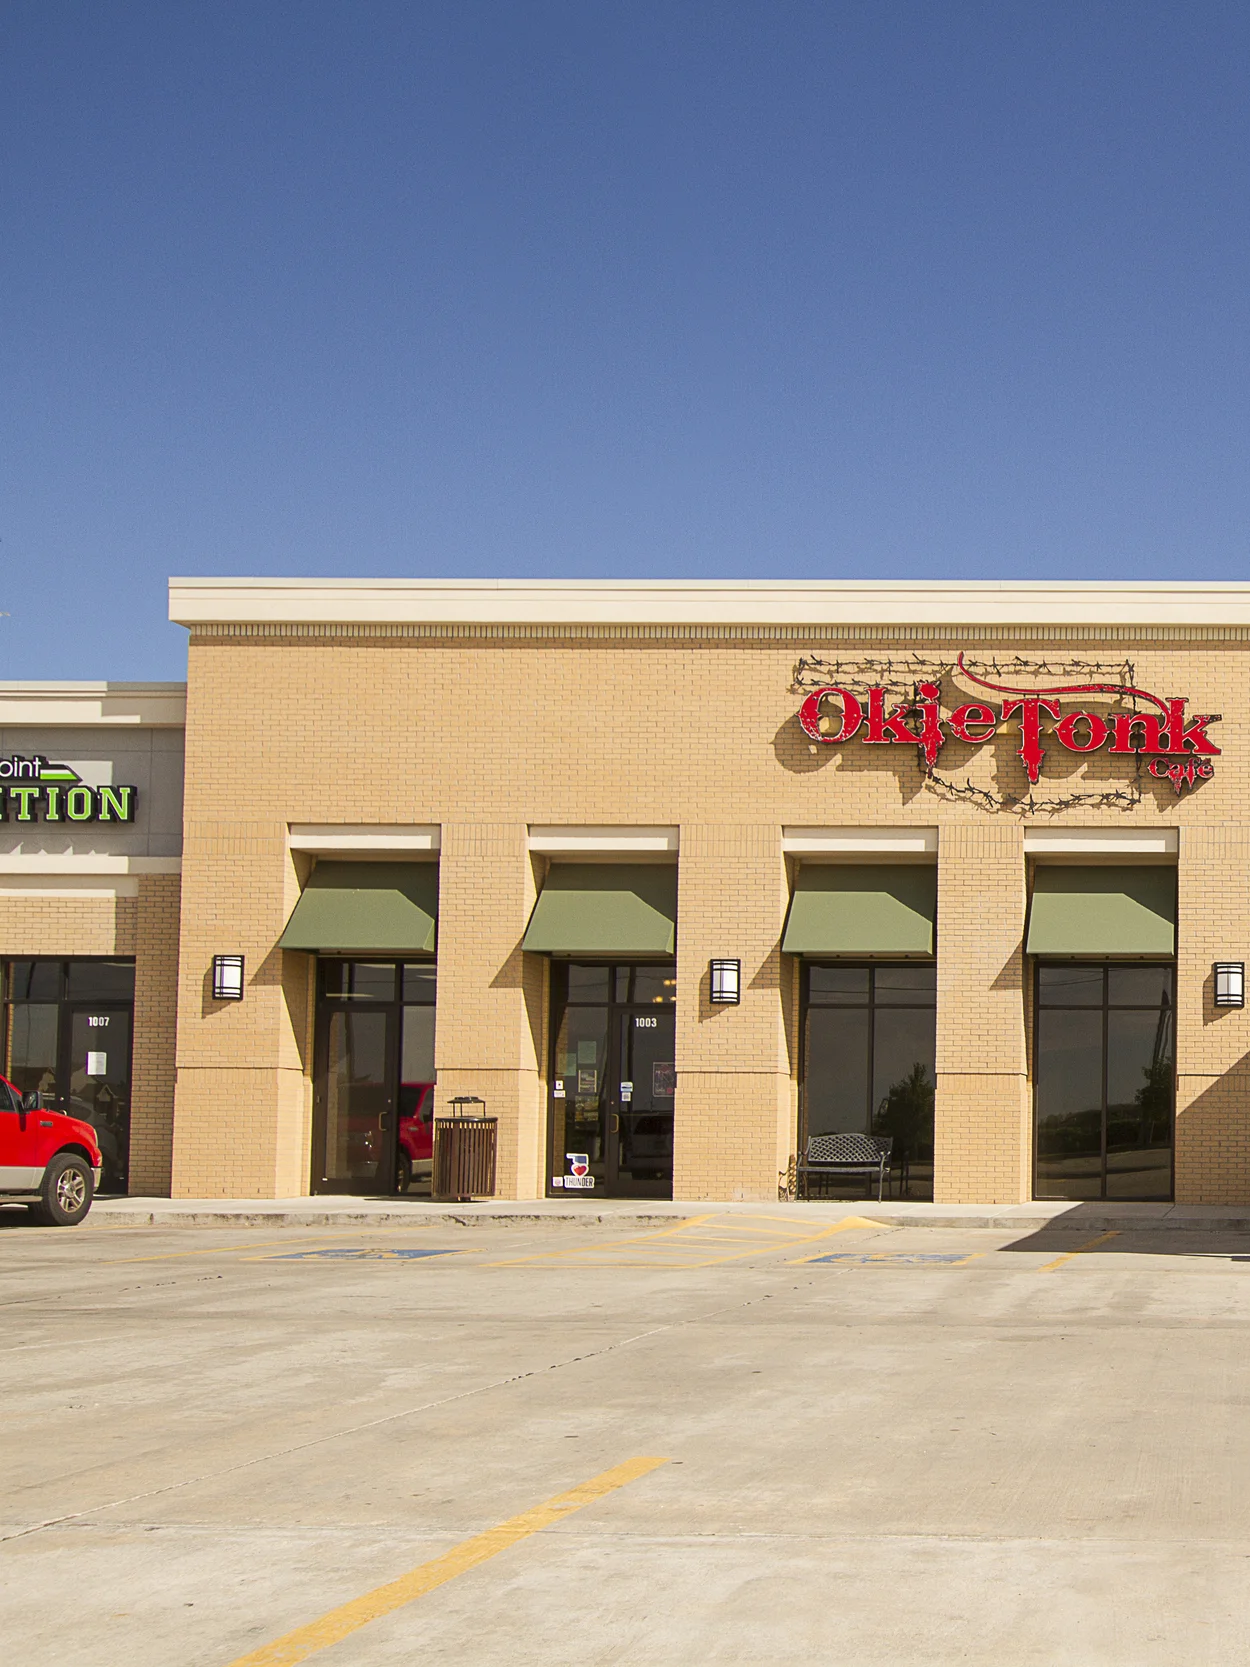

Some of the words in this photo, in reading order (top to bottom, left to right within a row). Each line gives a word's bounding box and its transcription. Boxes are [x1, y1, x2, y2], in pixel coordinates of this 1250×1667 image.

[0, 787, 131, 820] TION
[89, 1016, 110, 1026] 1007
[635, 1018, 657, 1027] 1003
[566, 1178, 593, 1187] THUNDER
